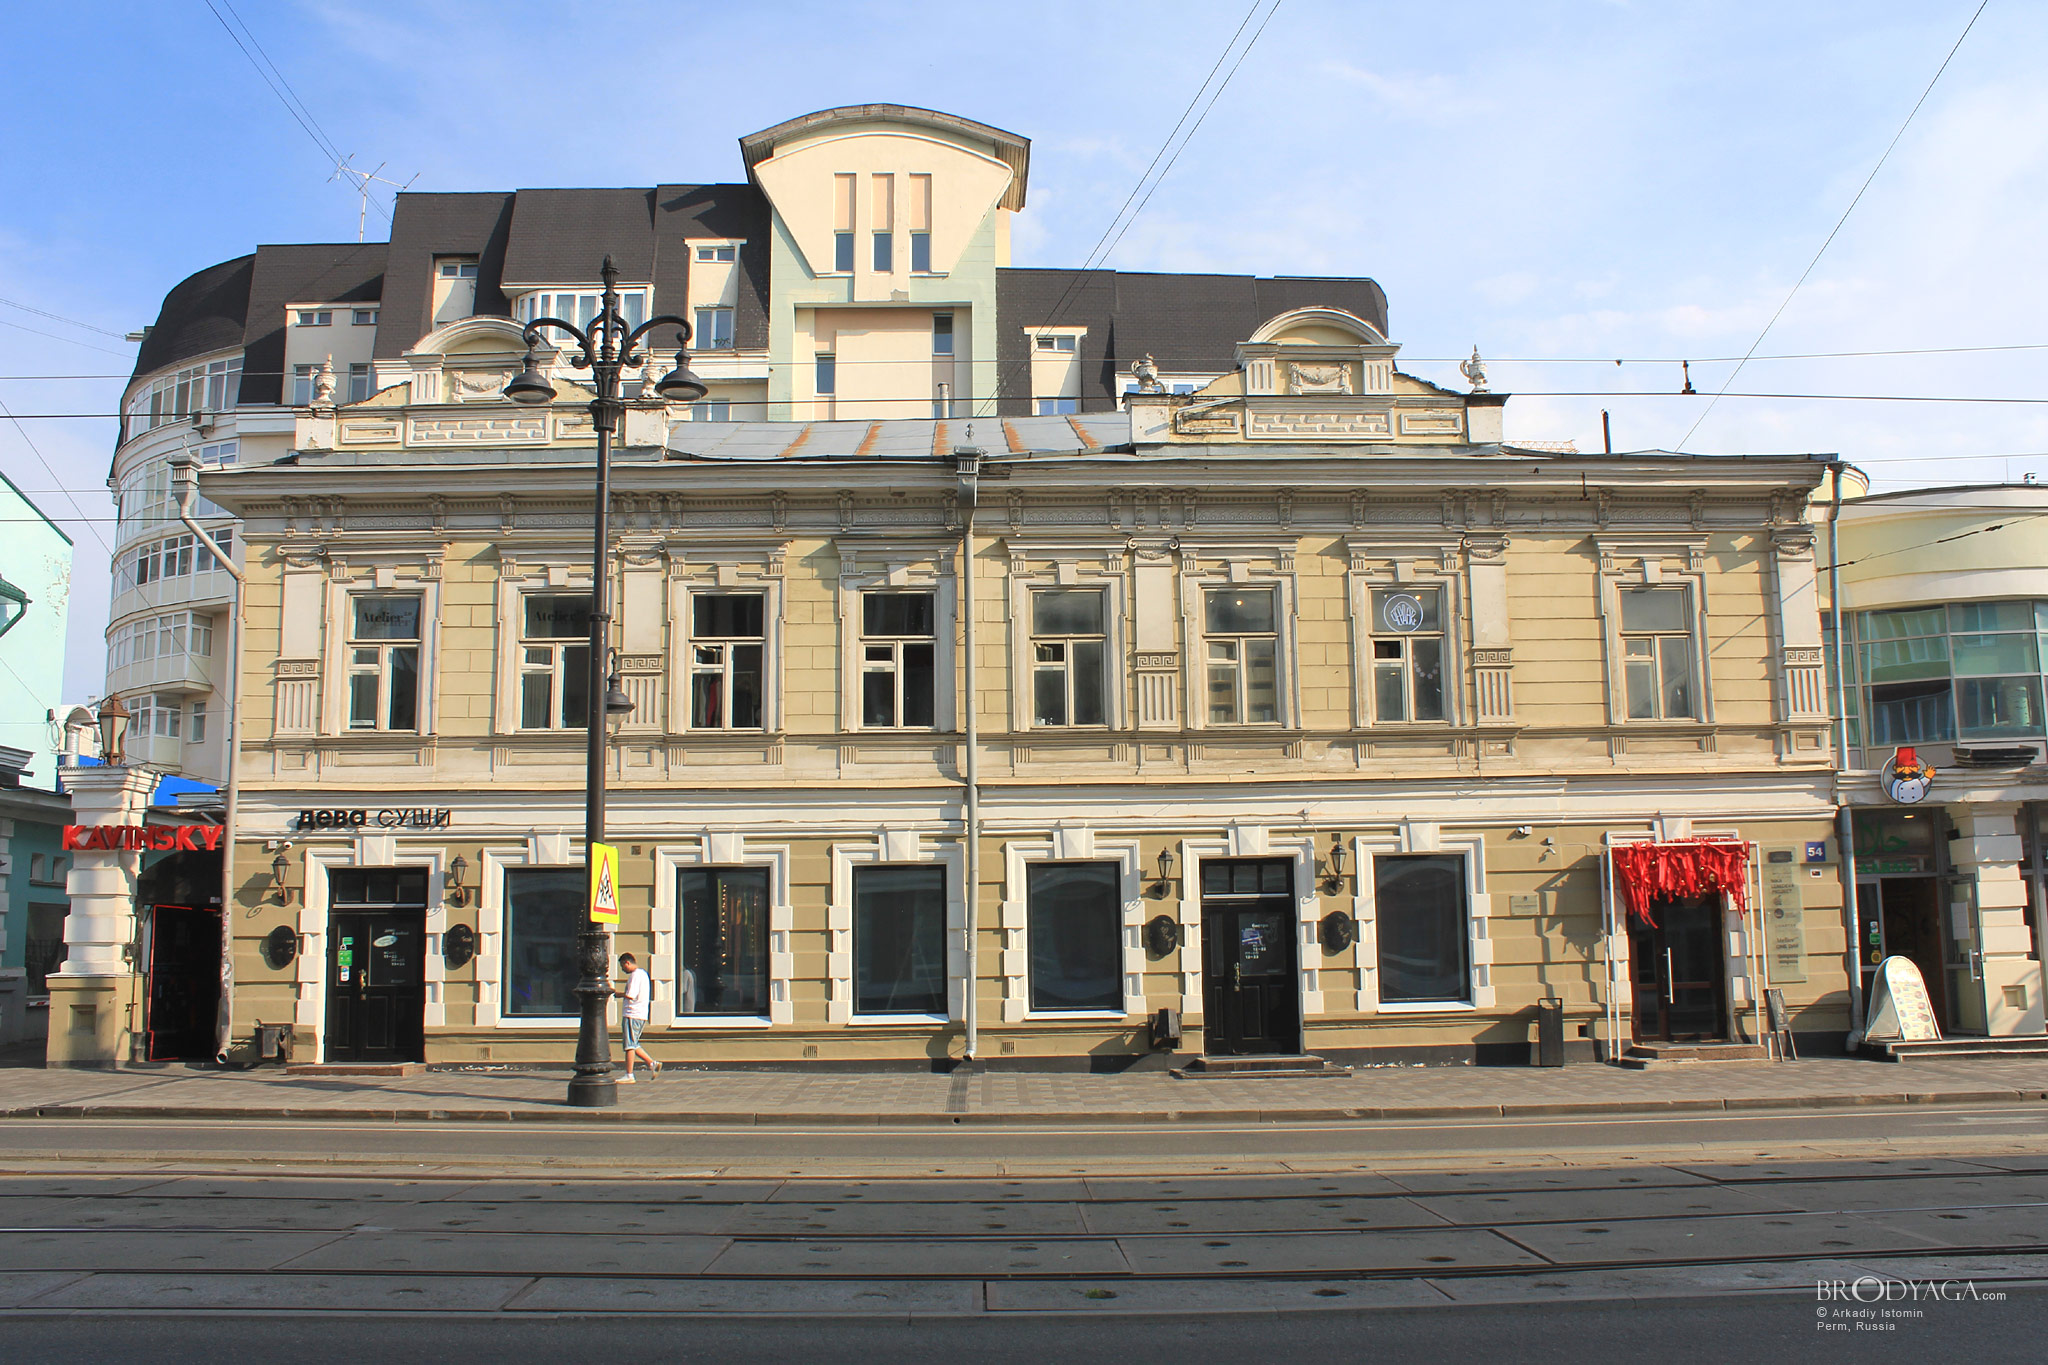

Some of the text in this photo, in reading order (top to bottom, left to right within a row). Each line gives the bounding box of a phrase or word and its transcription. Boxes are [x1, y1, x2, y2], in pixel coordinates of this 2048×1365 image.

[297, 808, 367, 831] дева
[61, 824, 225, 851] KAVINSKY
[1807, 846, 1824, 858] 54
